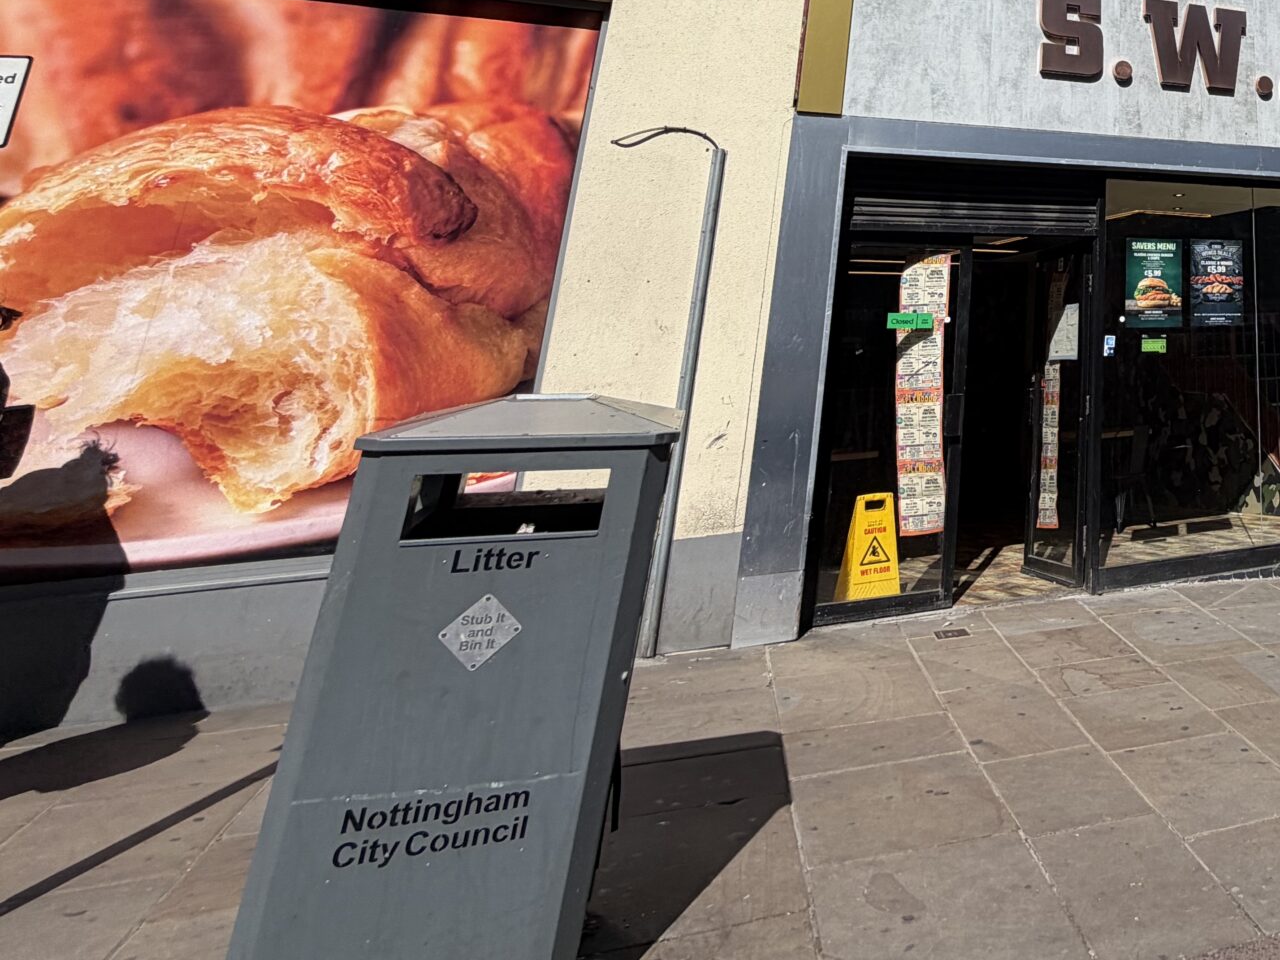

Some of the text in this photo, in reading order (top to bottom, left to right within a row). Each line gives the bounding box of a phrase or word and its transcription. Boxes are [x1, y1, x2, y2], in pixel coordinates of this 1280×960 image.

[1131, 242, 1177, 251] SAVERS MENU
[864, 526, 887, 536] CAUTION
[450, 547, 540, 574] Litter
[860, 566, 891, 577] WET FLOOR
[460, 613, 493, 626] Stub
[467, 626, 494, 638] and
[459, 639, 482, 652] Bin
[340, 790, 530, 834] Nottingham
[331, 815, 529, 868] City Council
